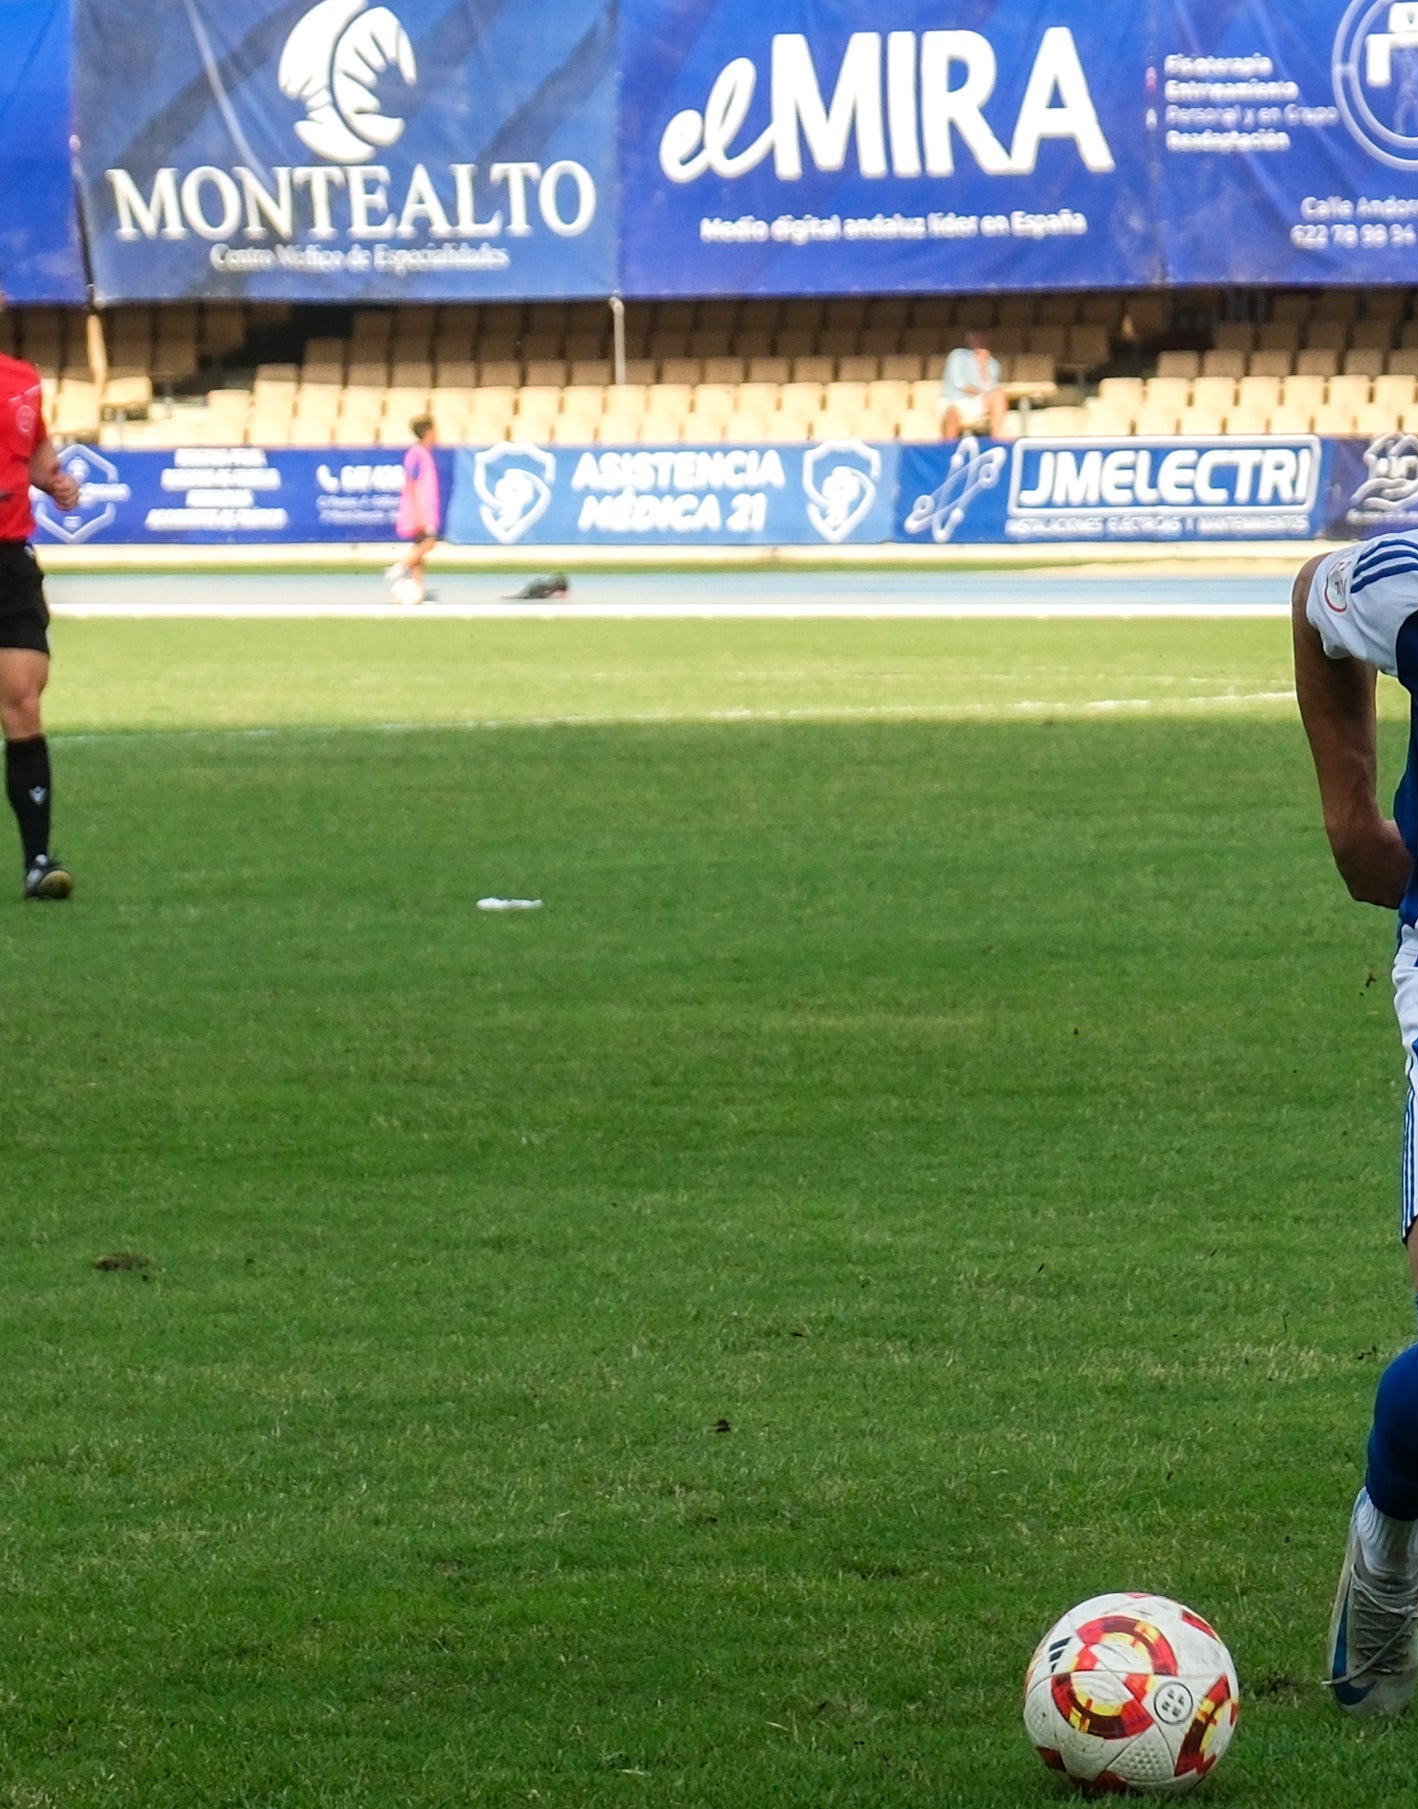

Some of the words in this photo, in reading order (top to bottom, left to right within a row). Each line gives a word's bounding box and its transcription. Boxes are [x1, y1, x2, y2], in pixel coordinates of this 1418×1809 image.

[105, 160, 597, 240] MONTEALTO
[571, 450, 786, 491] ASISTENCIA
[1018, 449, 1311, 506] JMELECTRI
